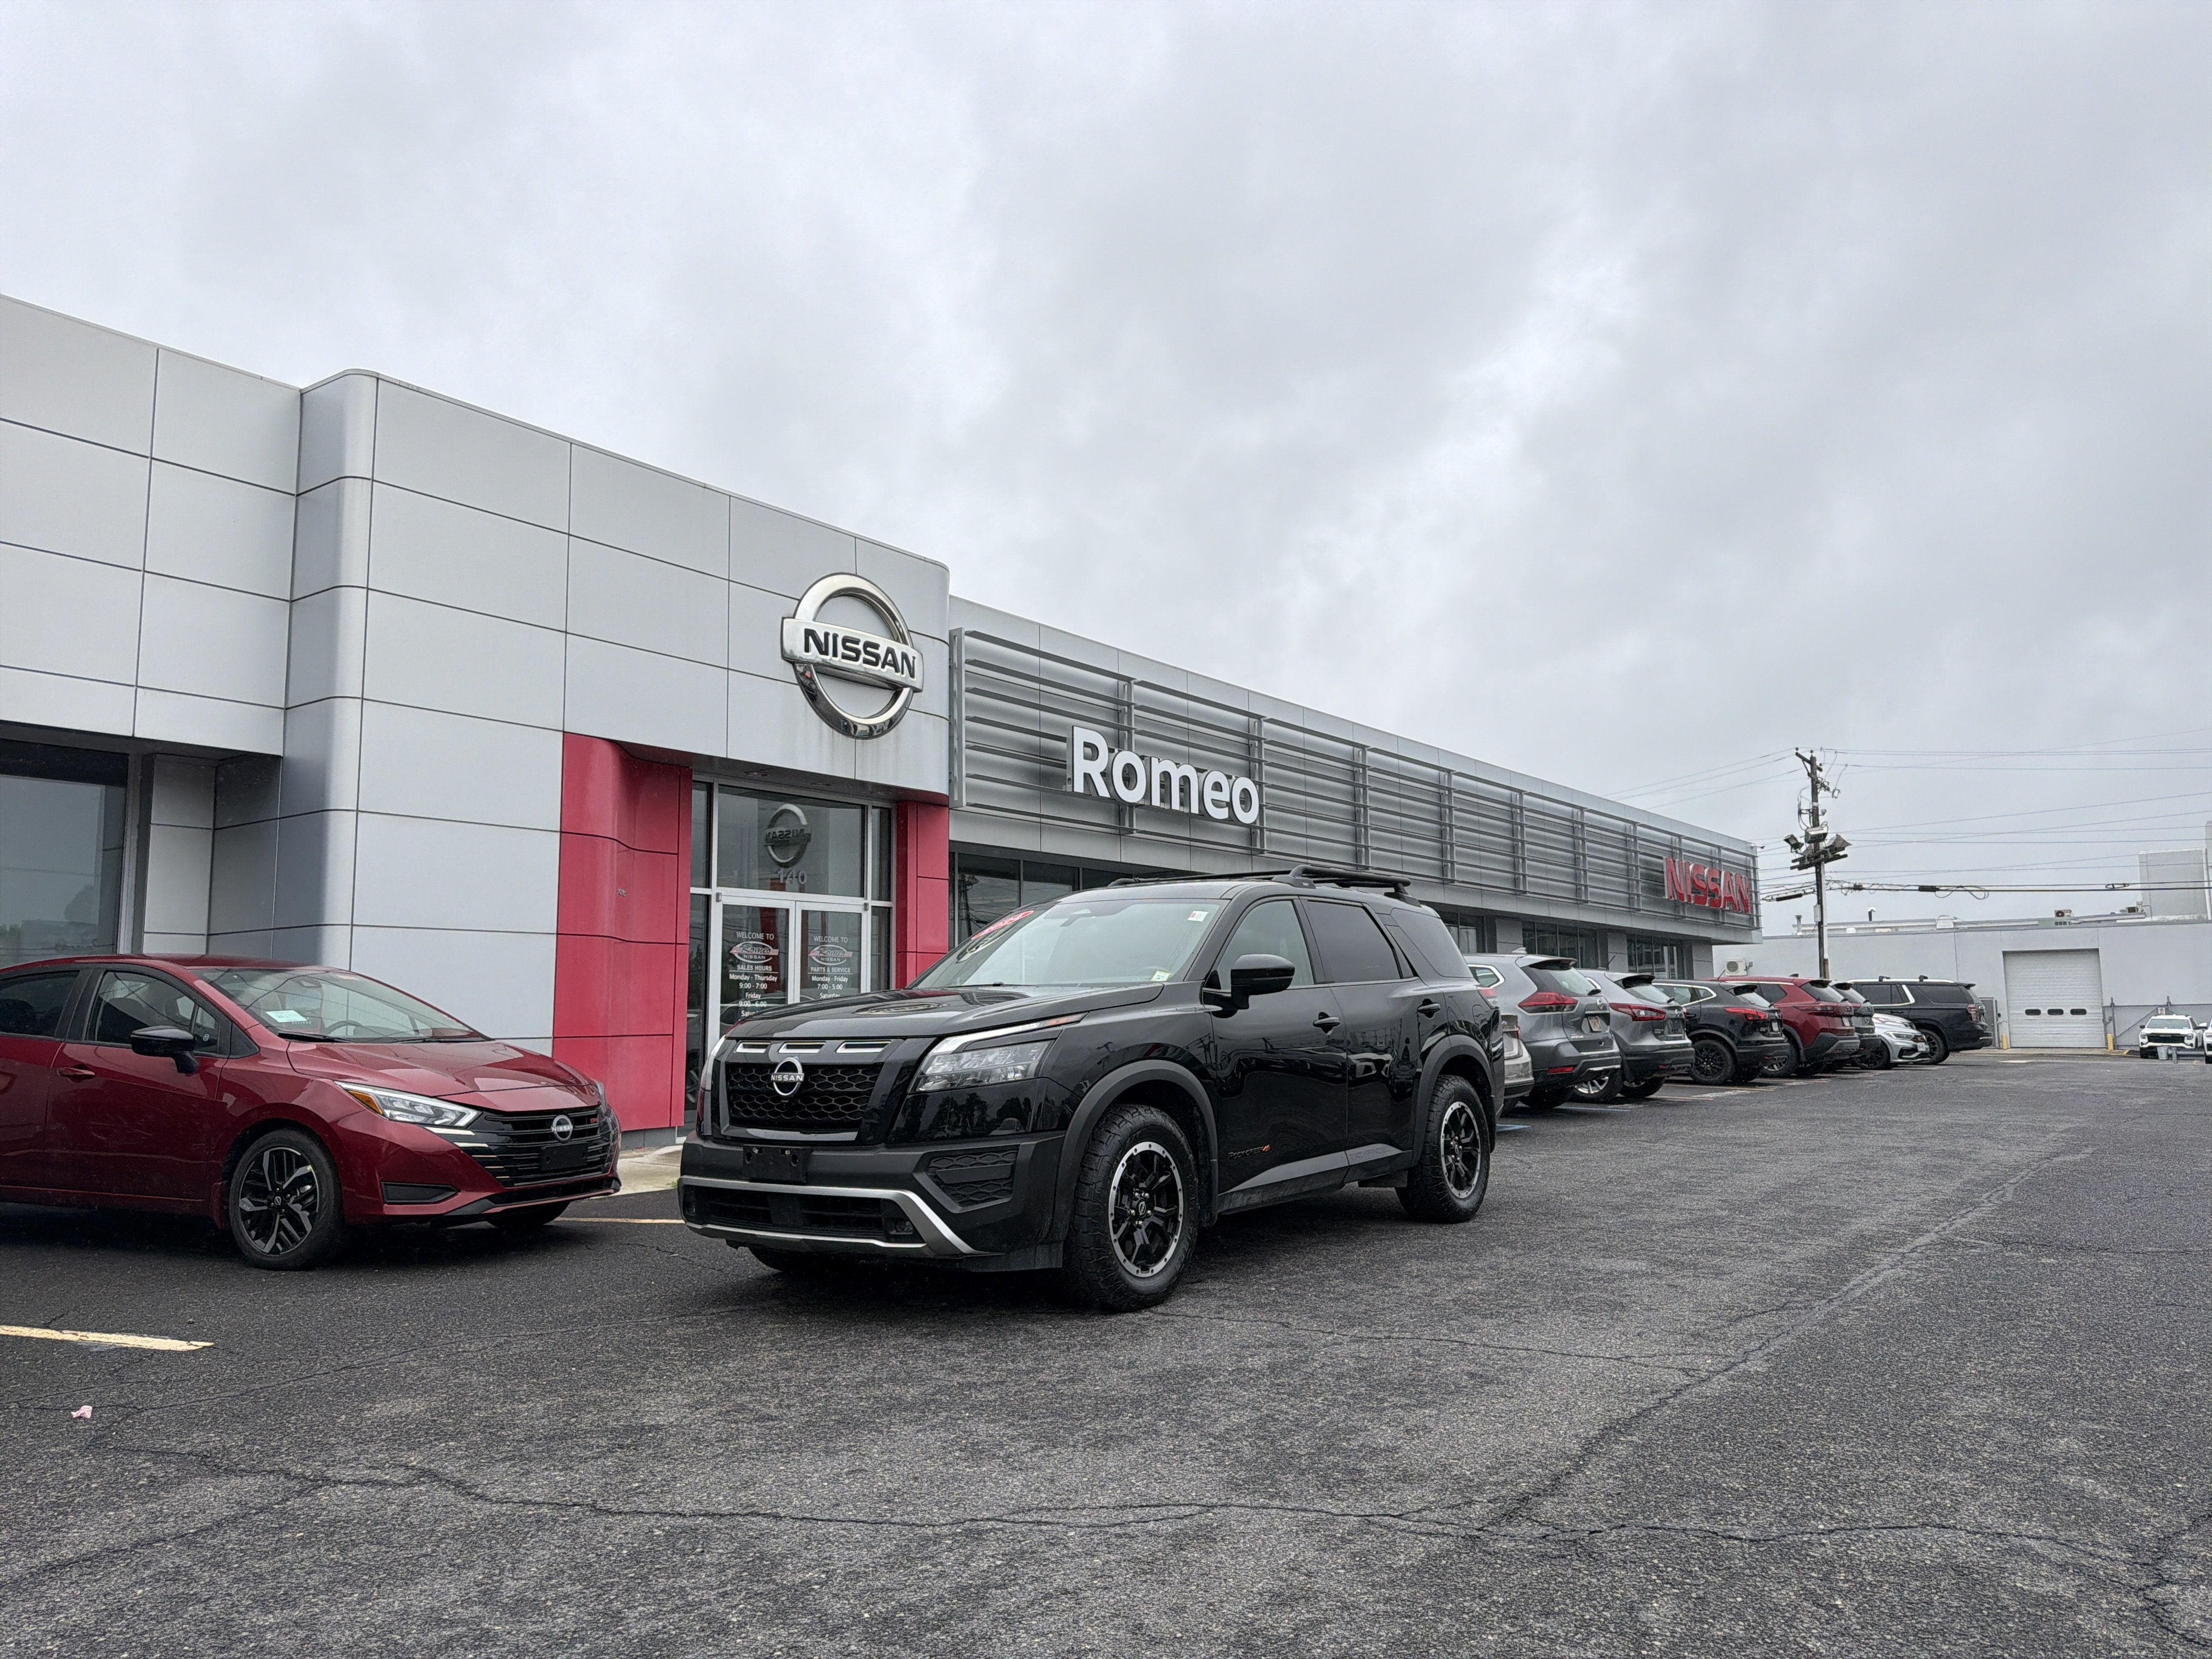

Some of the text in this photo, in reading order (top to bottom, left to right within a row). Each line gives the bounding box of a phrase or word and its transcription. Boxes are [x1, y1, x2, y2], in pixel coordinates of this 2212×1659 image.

[803, 628, 916, 679] NISSAN
[1070, 725, 1260, 824] Romeo
[777, 868, 808, 885] 140
[1664, 856, 1751, 913] NISSAN
[736, 931, 765, 940] WELCOME
[741, 944, 771, 954] Romeo
[817, 947, 845, 956] Romeo
[729, 973, 751, 981] Monday
